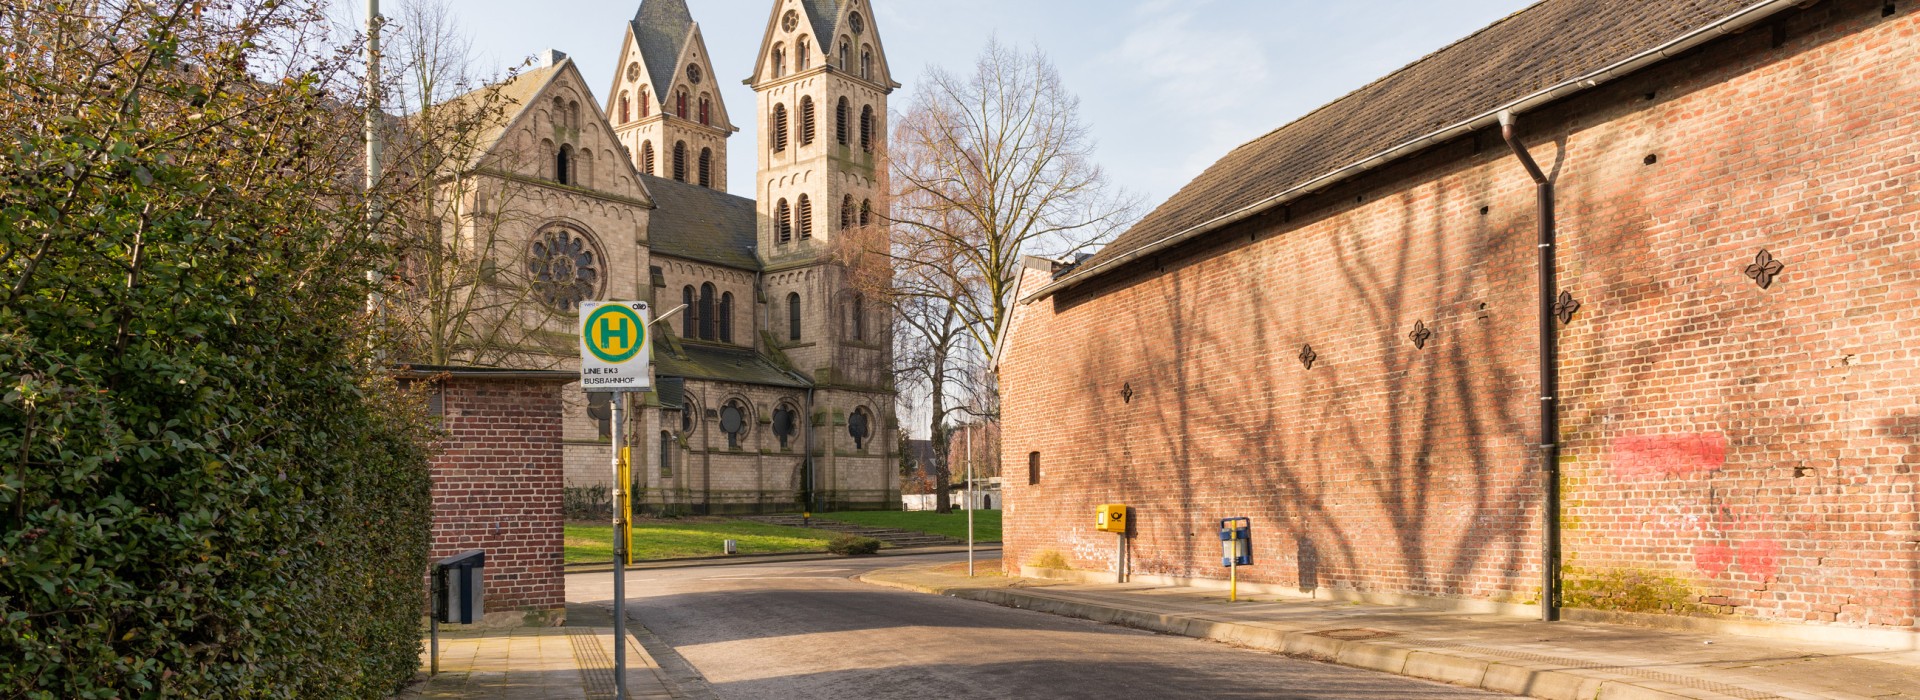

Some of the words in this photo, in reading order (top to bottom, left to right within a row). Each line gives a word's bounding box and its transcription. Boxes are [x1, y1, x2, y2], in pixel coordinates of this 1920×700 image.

[600, 317, 629, 349] H
[584, 367, 602, 375] LINIE
[584, 377, 635, 385] BUSBAHNHOF
